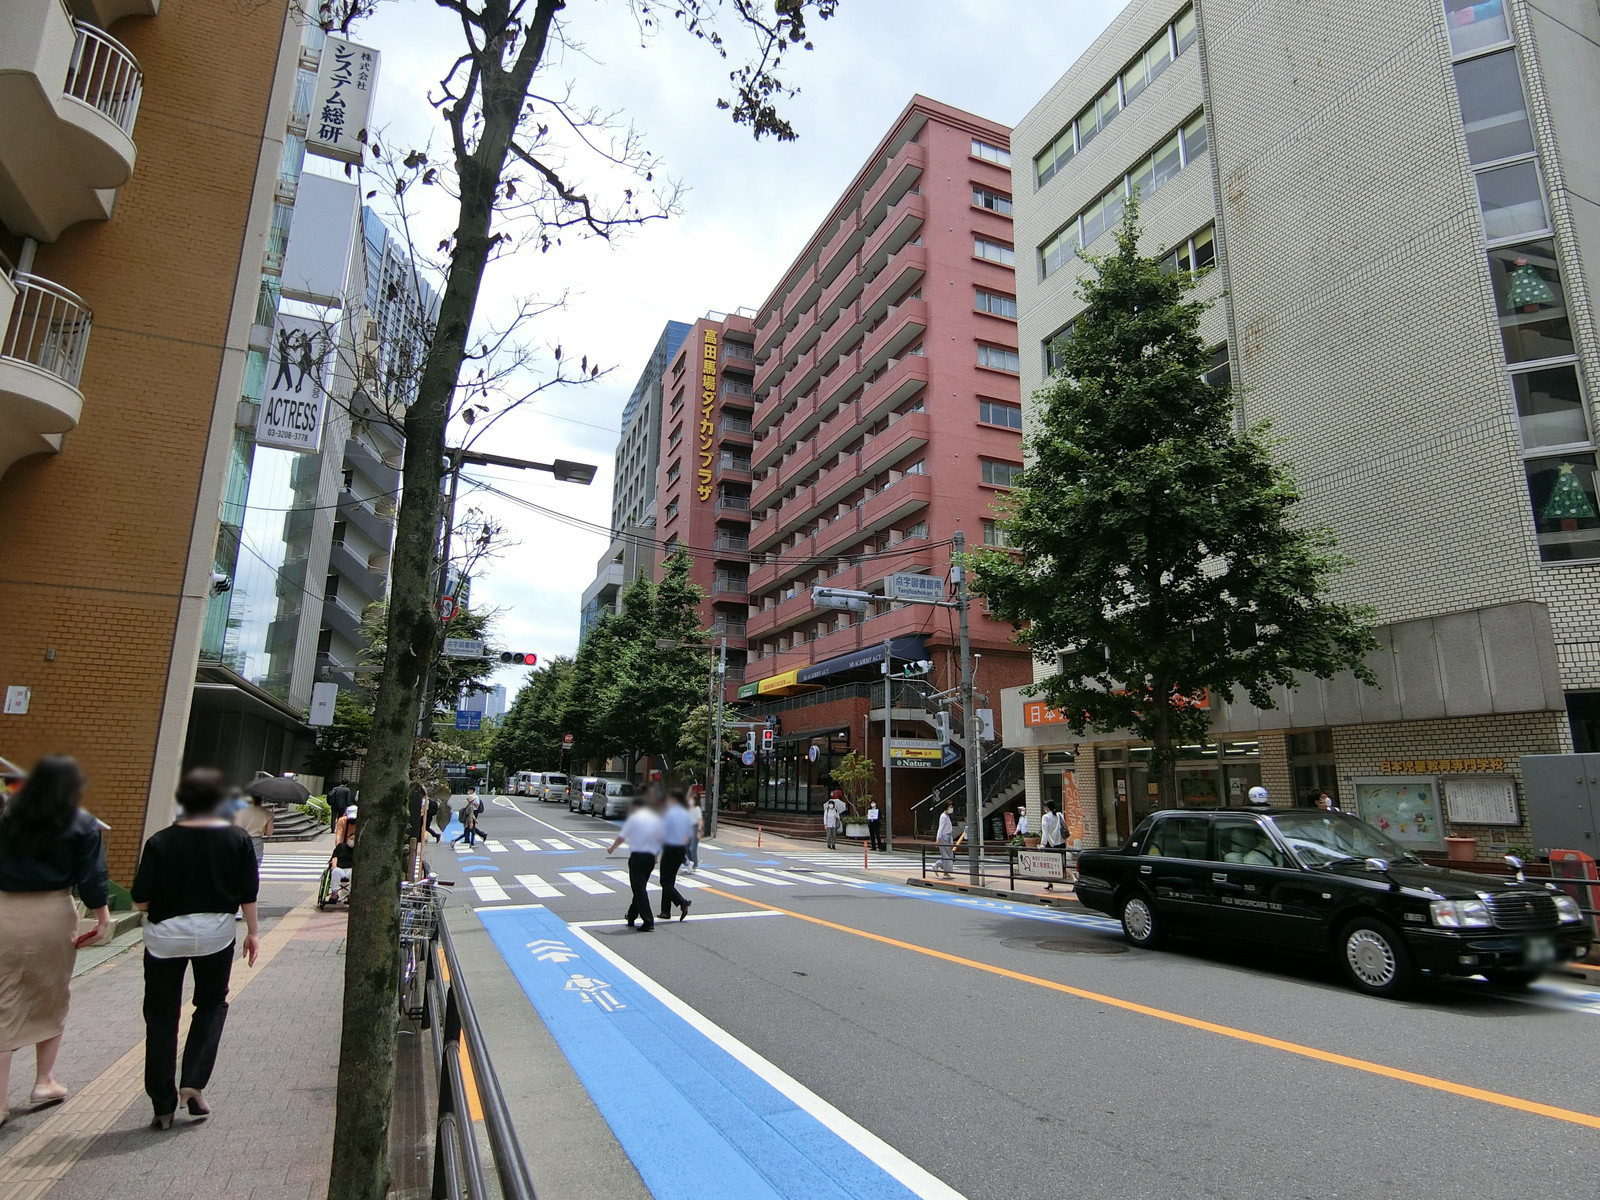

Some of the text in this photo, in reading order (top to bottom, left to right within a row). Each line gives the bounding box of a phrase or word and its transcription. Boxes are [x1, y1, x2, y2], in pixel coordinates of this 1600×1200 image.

[356, 52, 373, 91] 株式会社
[315, 44, 356, 144] システム総研
[264, 397, 318, 432] ACTRESS
[697, 328, 718, 501] 高田馬場ダイカンプラザ
[267, 428, 309, 442] 03-3208-3778
[902, 759, 932, 767] Nature
[1380, 757, 1505, 773] 日本児童教育専門学校
